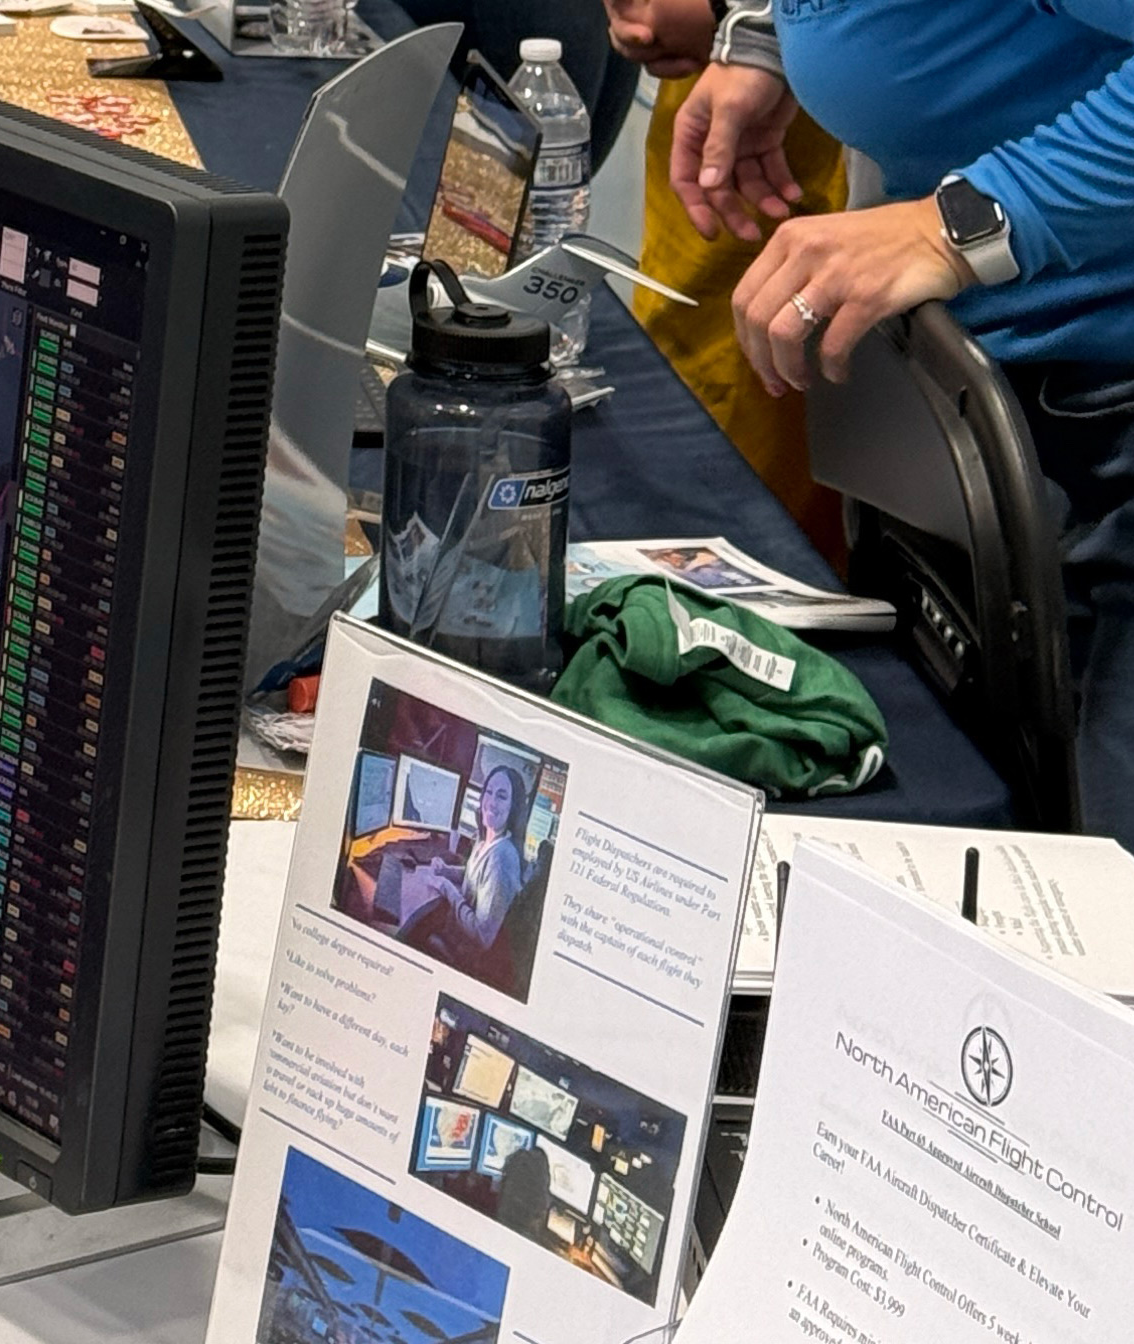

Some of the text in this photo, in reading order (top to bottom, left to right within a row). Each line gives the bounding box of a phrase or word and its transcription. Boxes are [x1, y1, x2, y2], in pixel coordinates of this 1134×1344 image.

[523, 275, 579, 304] 350
[569, 861, 585, 877] 121
[586, 869, 619, 893] Federal
[572, 846, 613, 872] employed
[613, 860, 624, 877] by
[625, 867, 640, 883] US
[640, 874, 673, 899] Airlines
[675, 891, 700, 912] under
[575, 827, 601, 847] Flight
[602, 839, 651, 871] Dispatchers
[668, 869, 707, 897] required
[564, 894, 585, 914] They
[585, 904, 609, 925] share
[560, 913, 579, 930] with
[579, 920, 594, 935] the
[593, 928, 626, 952] captain
[627, 943, 639, 958] of
[637, 948, 658, 967] each
[813, 1141, 845, 1175] Career!
[835, 1031, 1124, 1232] North American Flight Control
[817, 1120, 1091, 1319] Earn your FAA Aircraft Dispatcher Certificate & Elevate Your
[1035, 1211, 1061, 1238] School
[812, 1241, 906, 1318] Program Cost: $3,999
[819, 1224, 888, 1282] online programs.
[824, 1198, 851, 1229] North
[851, 1220, 893, 1259] American
[894, 1248, 922, 1279] Flight
[923, 1269, 957, 1304] Control
[957, 1293, 987, 1326] Offers
[987, 1315, 996, 1330] 5
[788, 1307, 801, 1323] an
[796, 1283, 819, 1312] FAA
[819, 1299, 858, 1339] Requires
